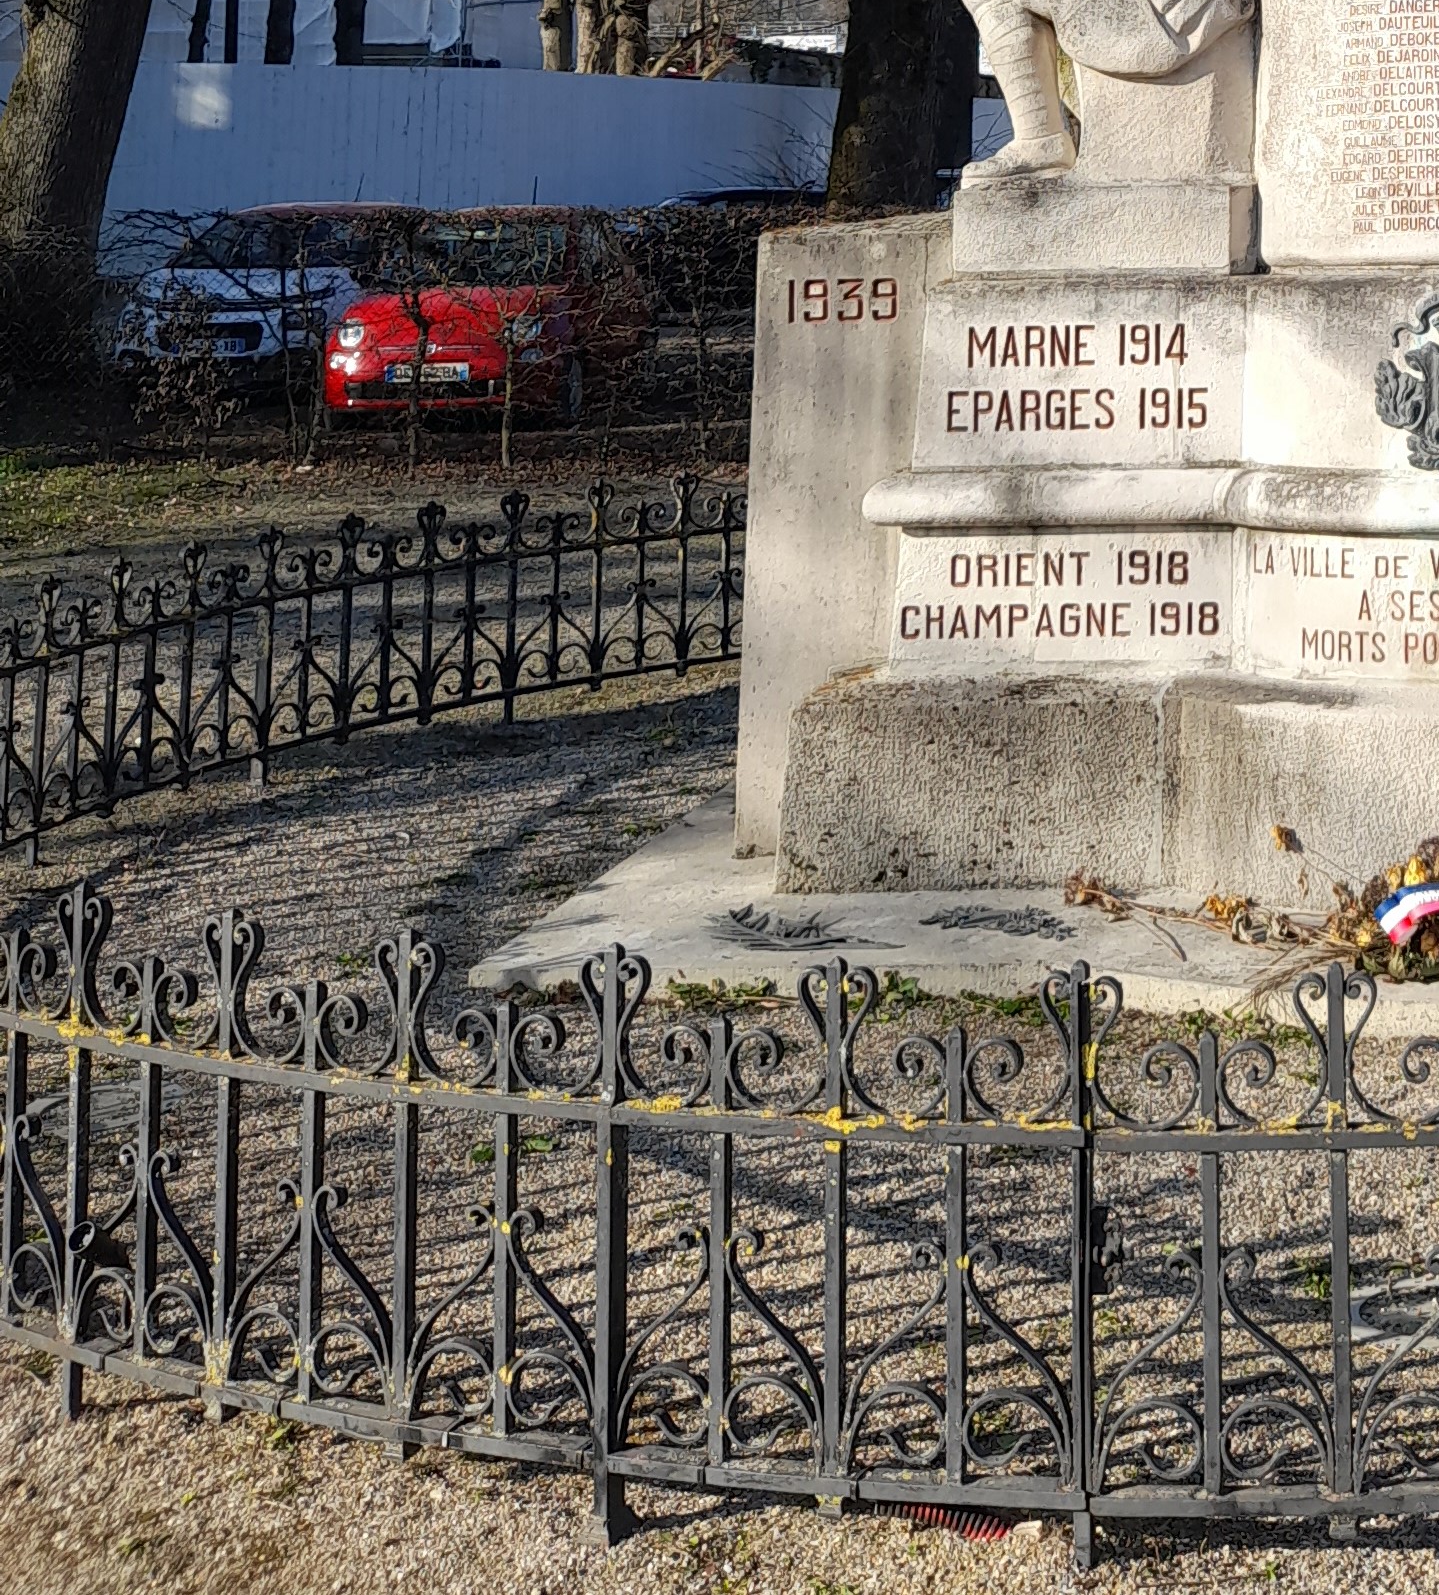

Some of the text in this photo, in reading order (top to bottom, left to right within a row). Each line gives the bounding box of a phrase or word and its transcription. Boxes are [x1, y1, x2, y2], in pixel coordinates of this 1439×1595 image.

[788, 278, 897, 324] 1939
[967, 323, 1188, 368] MARNE 1914
[947, 387, 1208, 432] EPARGES 1915
[950, 550, 1188, 587] ORIENT 1918
[1254, 544, 1274, 574] LA
[1291, 546, 1354, 578] VILLE
[1375, 556, 1409, 578] DE
[901, 602, 1219, 639] CHAMPAGNE 1918
[1358, 589, 1371, 621] A
[1302, 627, 1385, 662] MORTS
